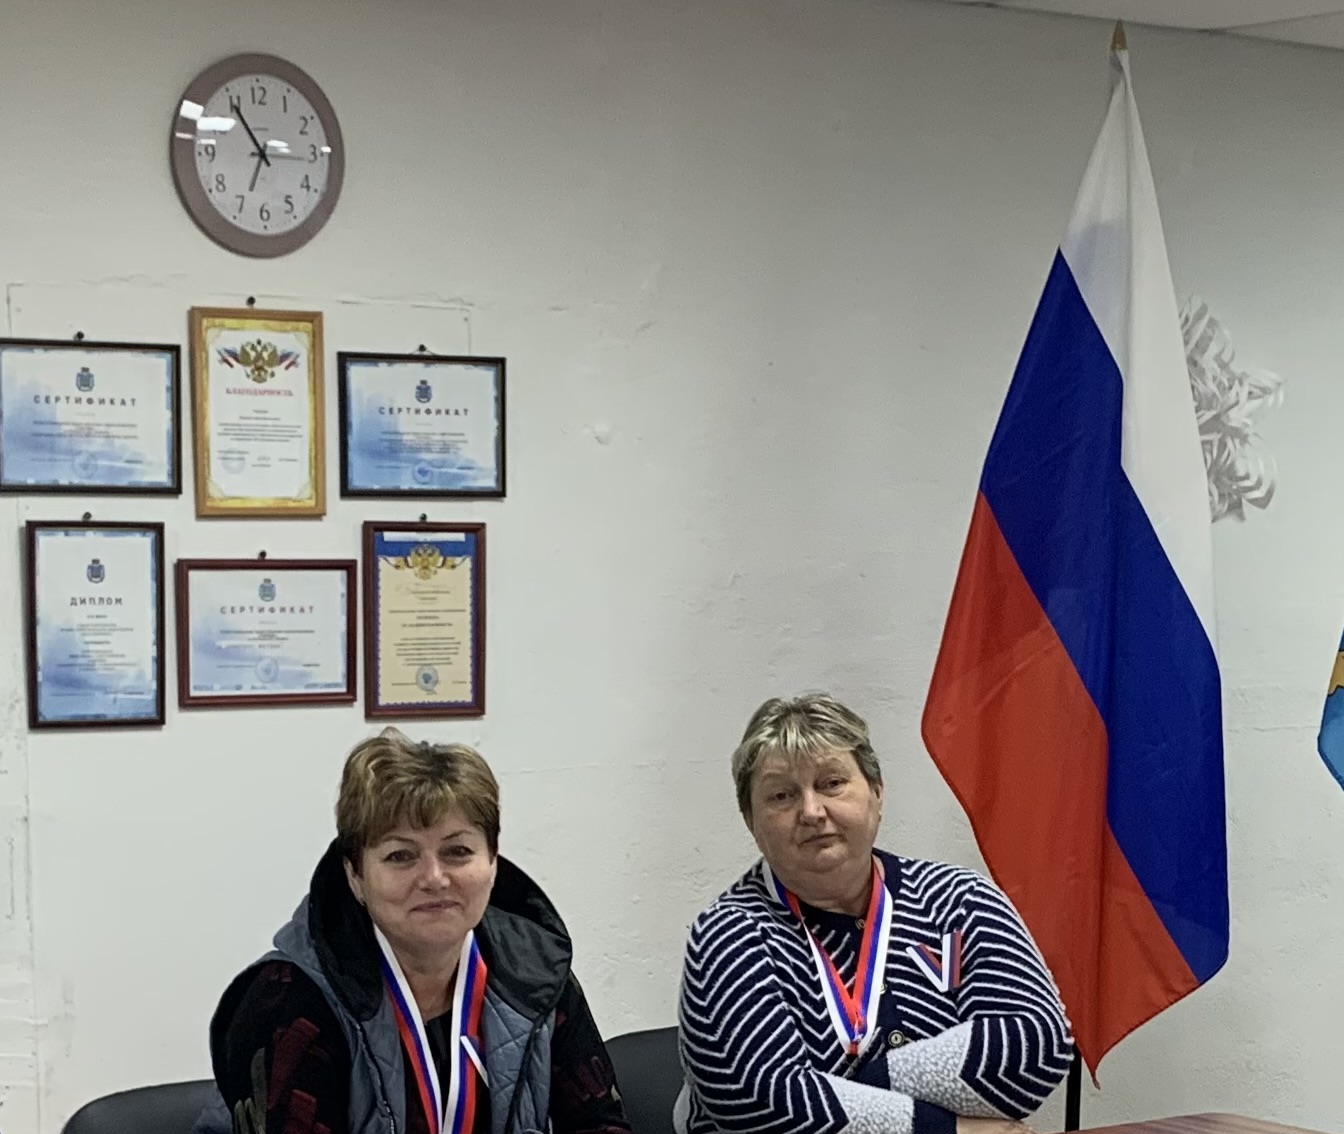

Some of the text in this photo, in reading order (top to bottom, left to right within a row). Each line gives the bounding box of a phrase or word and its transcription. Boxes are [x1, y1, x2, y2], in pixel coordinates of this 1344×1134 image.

[250, 86, 267, 106] 12
[299, 116, 309, 135] 2
[205, 144, 216, 163] 9
[308, 144, 318, 163] 3
[215, 173, 226, 193] 8
[300, 174, 311, 192] 4
[235, 195, 245, 214] 7
[260, 203, 270, 222] 6
[284, 195, 295, 214] 5
[33, 395, 137, 407] СЕРТИФИКАТ
[378, 407, 469, 417] СЕРТИФИКАТ
[70, 597, 123, 606] ДИПЛОМ
[220, 606, 315, 615] СЕРТИФИКАТ
